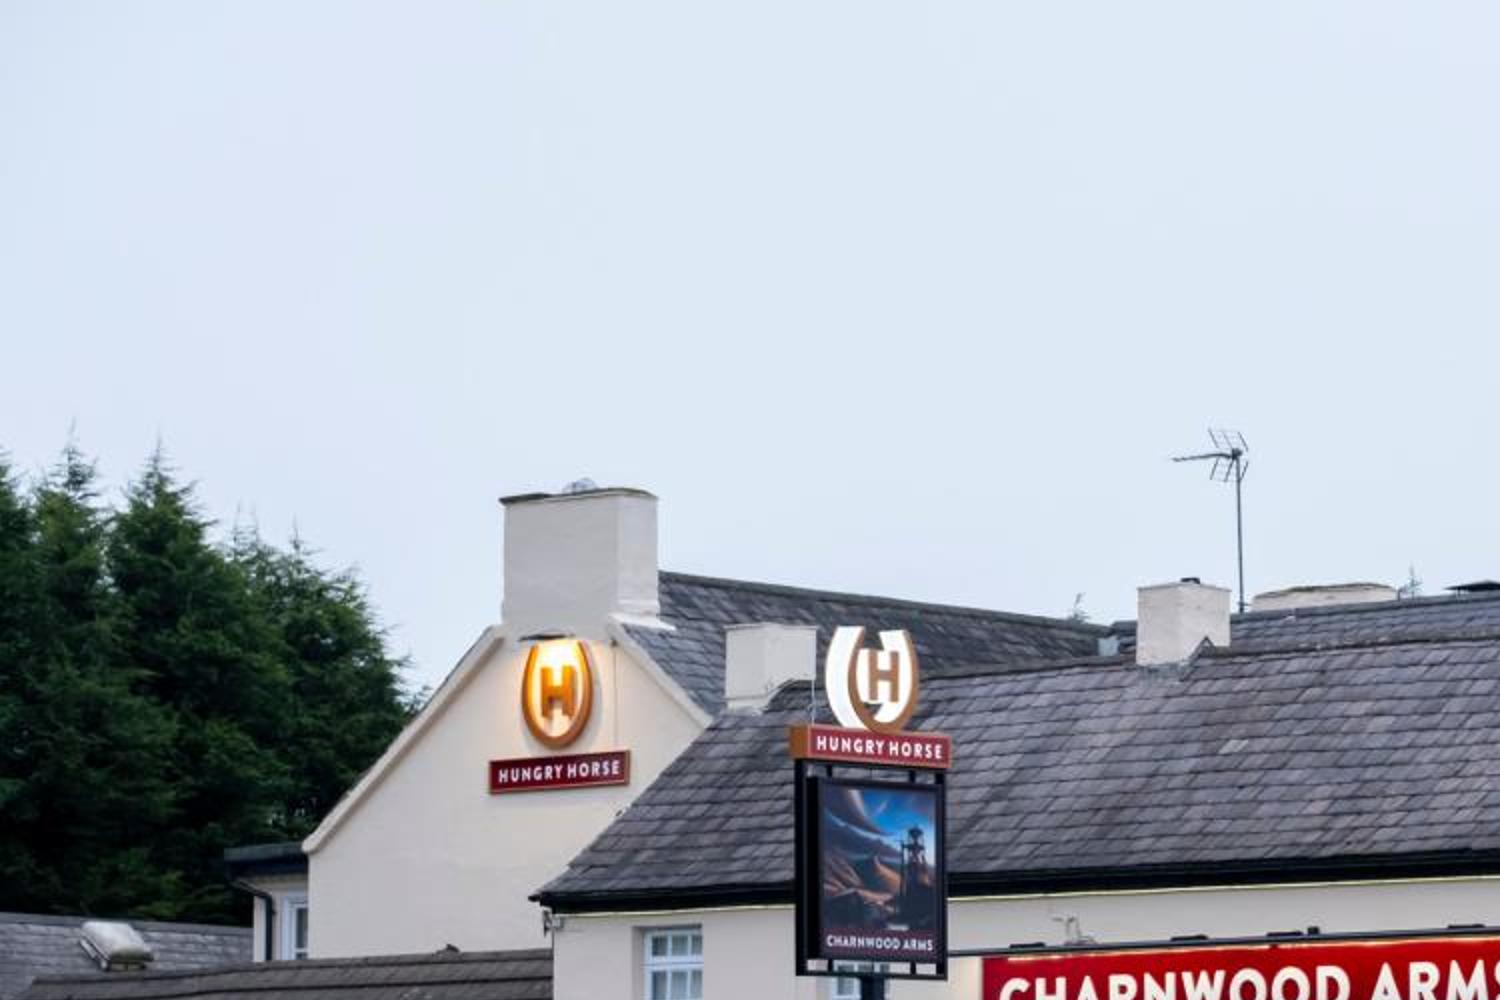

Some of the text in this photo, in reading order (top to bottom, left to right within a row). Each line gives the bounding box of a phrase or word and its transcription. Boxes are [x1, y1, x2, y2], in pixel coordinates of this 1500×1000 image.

[541, 665, 575, 720] H
[816, 735, 943, 760] HUNGRY HORSE
[498, 759, 621, 783] HUNGRY HORSE
[826, 935, 934, 951] CHARNWOOD ARMS
